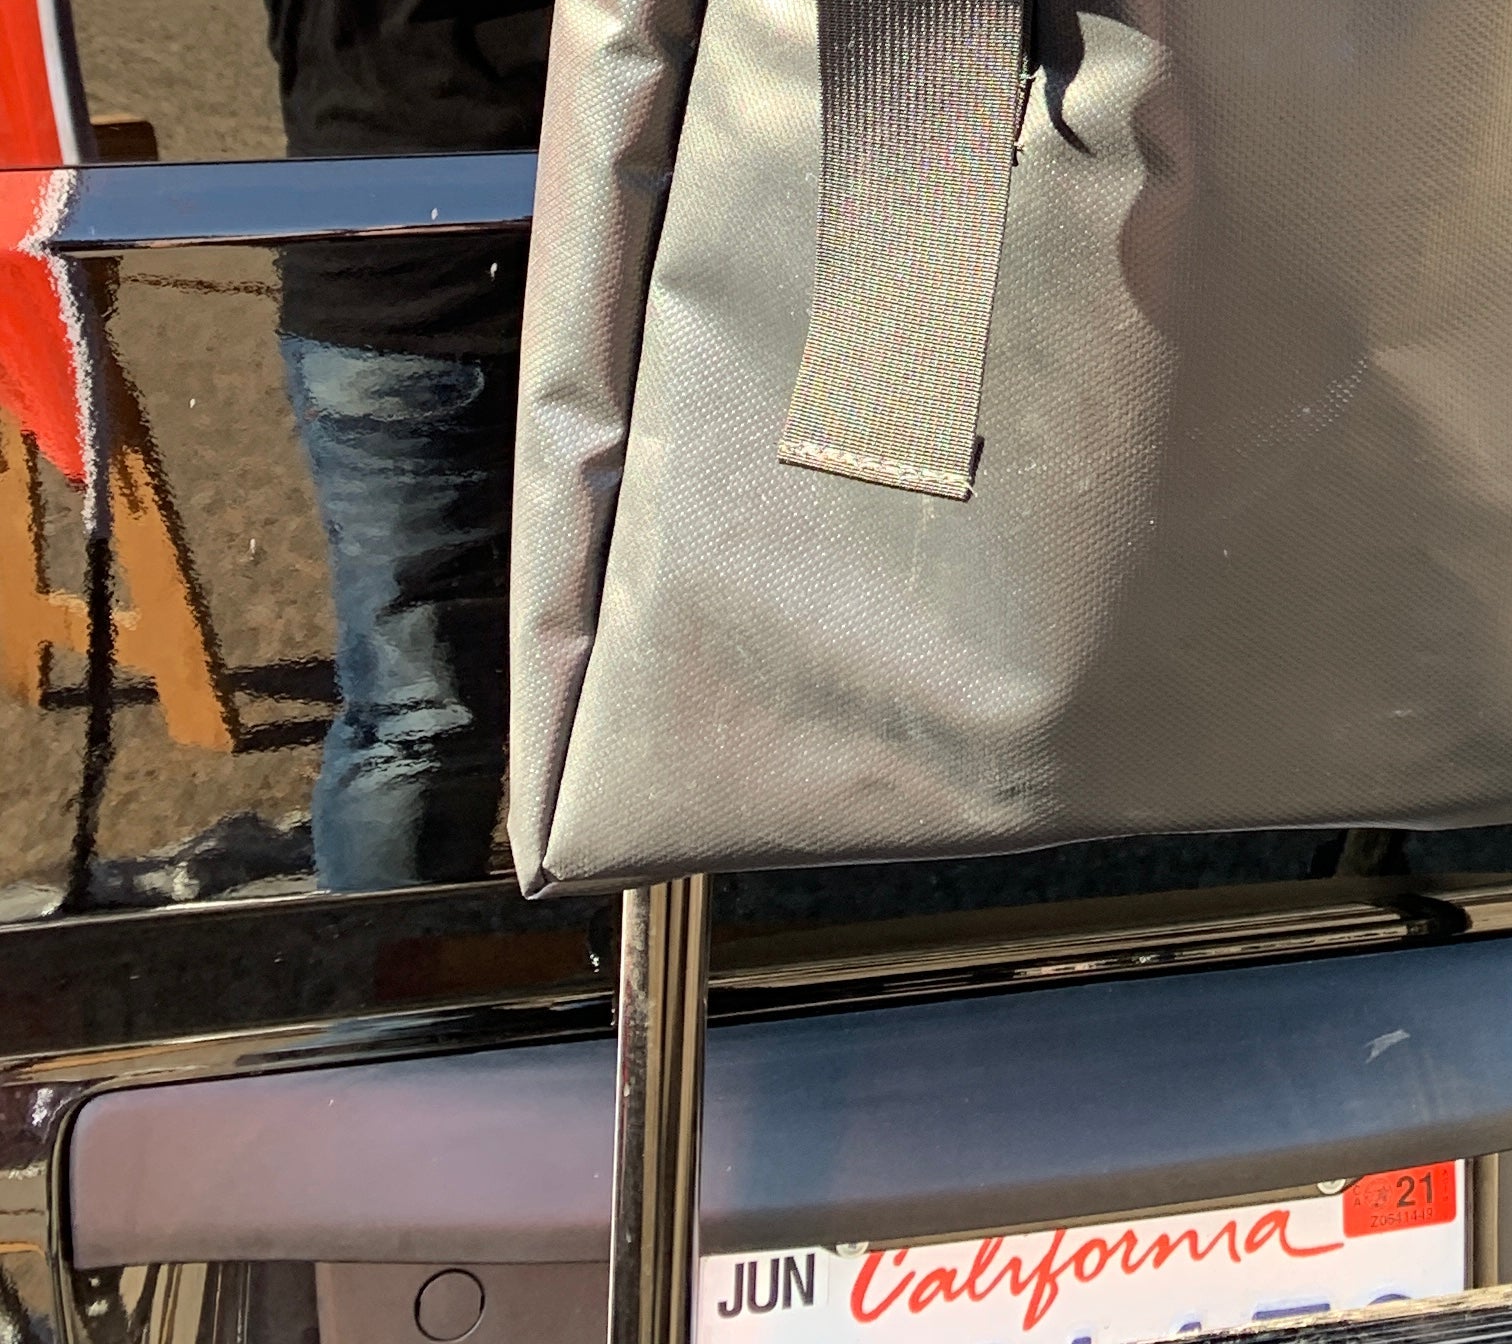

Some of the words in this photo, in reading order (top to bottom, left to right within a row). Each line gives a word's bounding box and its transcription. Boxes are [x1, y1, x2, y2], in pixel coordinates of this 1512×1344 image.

[1396, 1171, 1433, 1208] 21
[718, 1253, 815, 1318] JUN
[850, 1210, 1344, 1330] California
